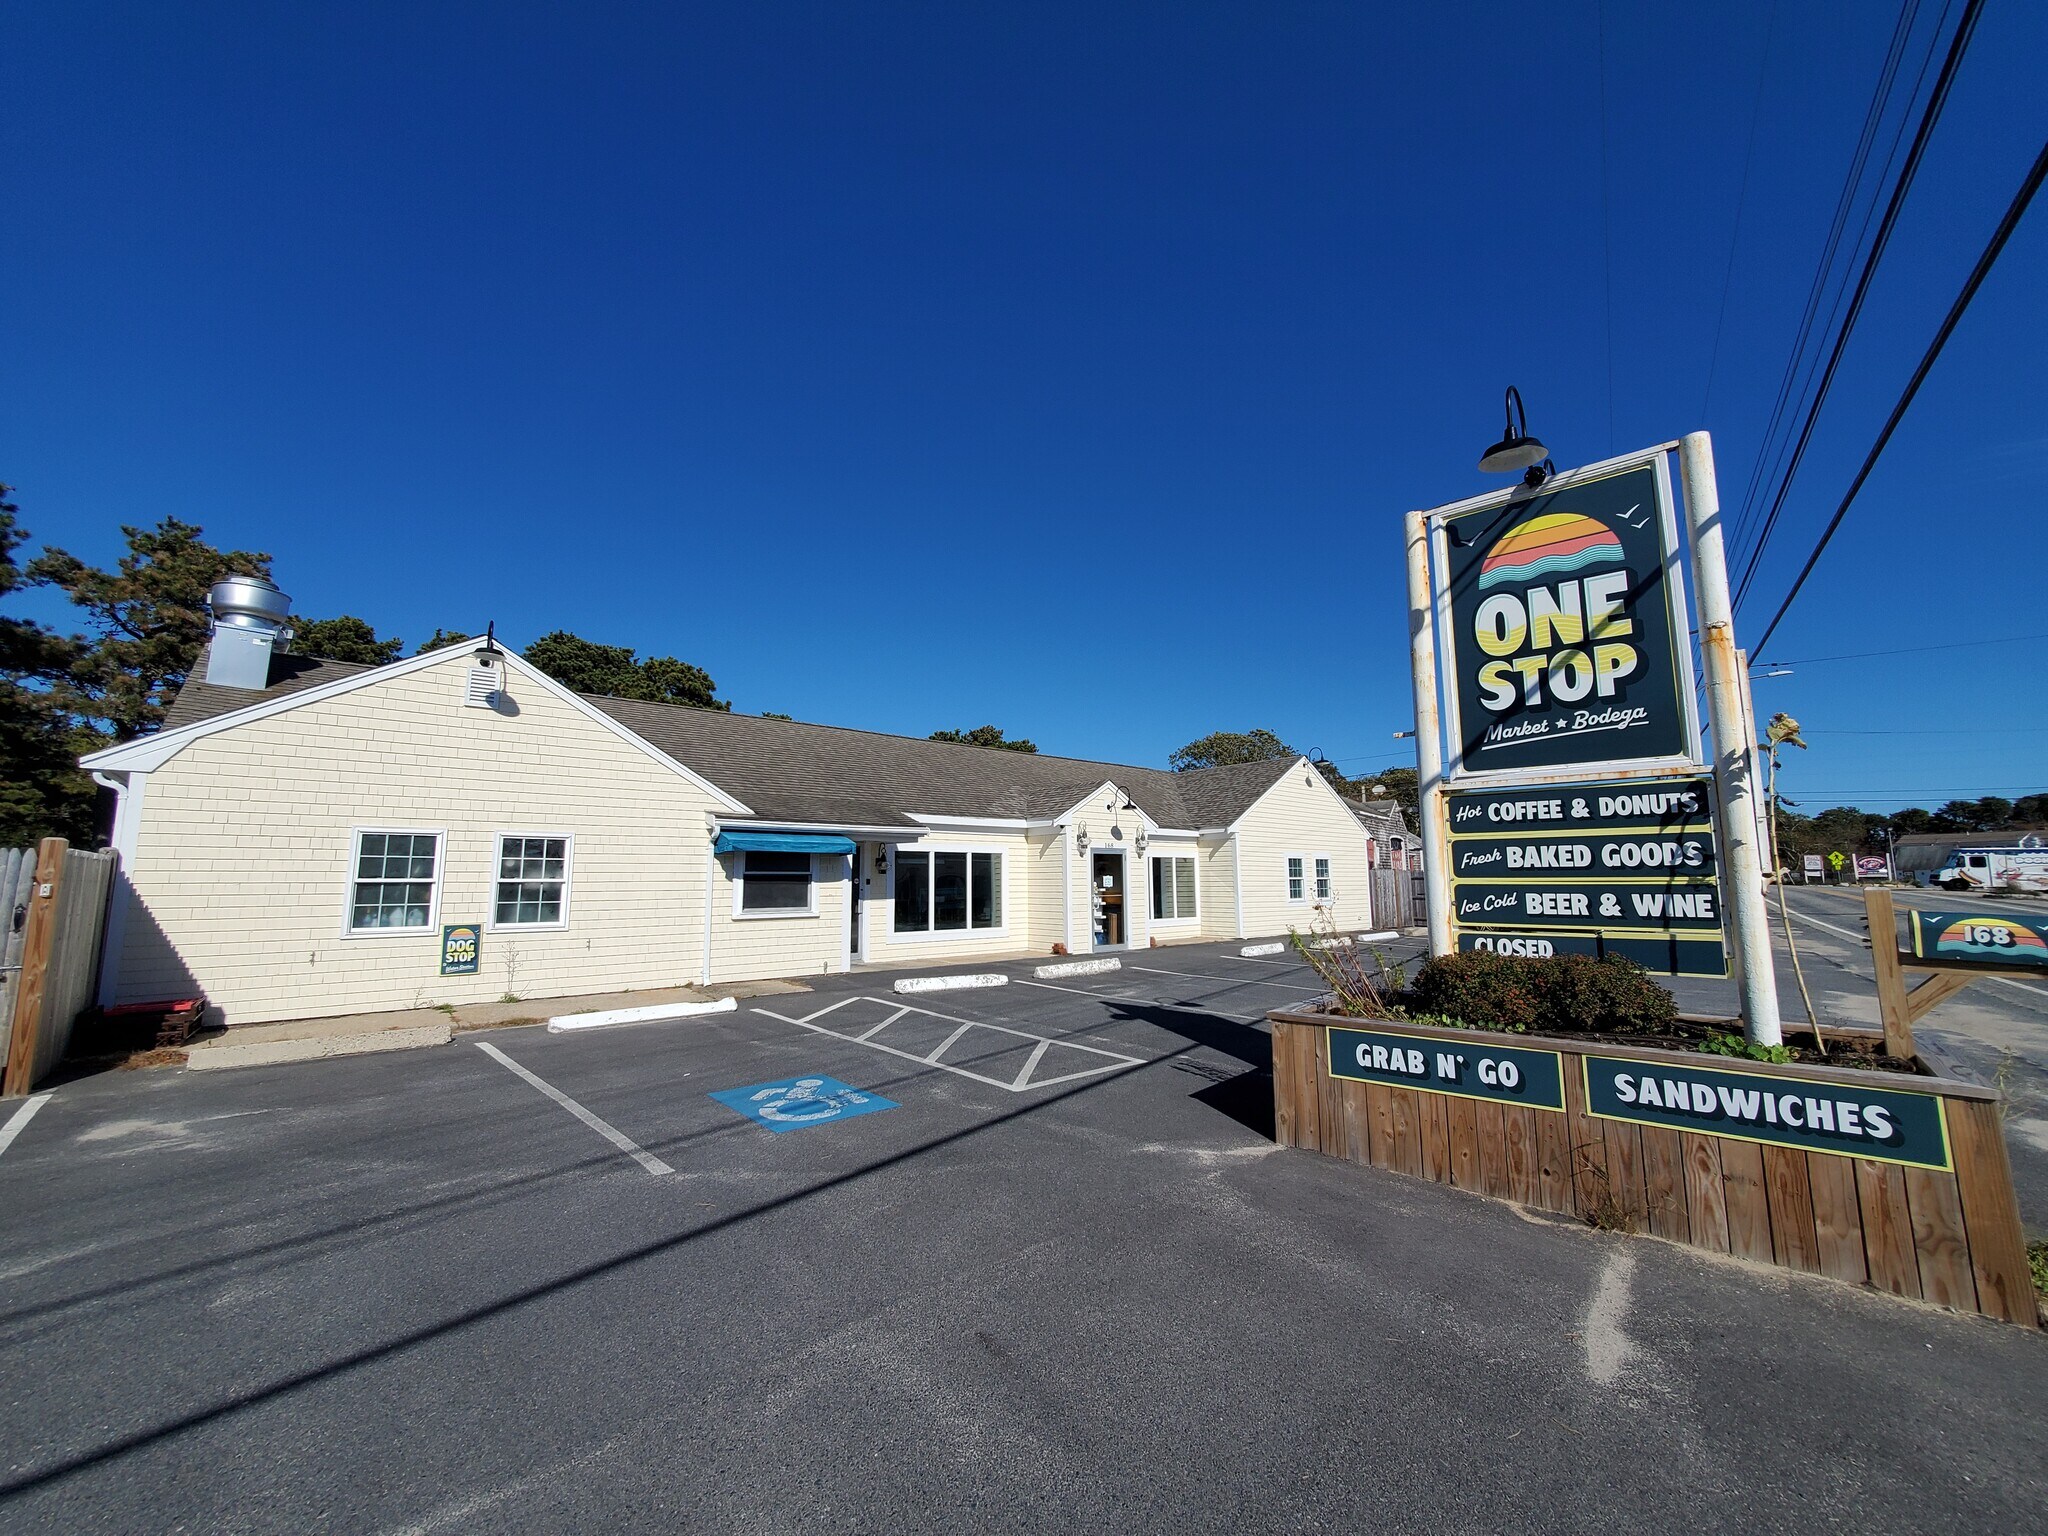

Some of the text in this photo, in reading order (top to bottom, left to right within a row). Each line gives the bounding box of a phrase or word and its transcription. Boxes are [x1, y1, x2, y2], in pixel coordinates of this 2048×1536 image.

[1475, 570, 1633, 657] ONE
[1478, 643, 1638, 711] STOP
[1484, 706, 1648, 742] Market Bodega
[1456, 792, 1699, 822] Hot COFFEE & DONUTS
[1461, 841, 1703, 870] Fresh BAKED GOODS
[1460, 892, 1715, 918] Ice Cold BEER & WINE
[446, 939, 475, 953] DOG
[1474, 937, 1553, 959] CLOSED
[1963, 925, 2011, 944] 168
[445, 951, 476, 963] STOP
[1356, 1042, 1426, 1076] GRAB
[1477, 1058, 1519, 1088] GO
[1614, 1073, 1894, 1140] SANDWICHES
